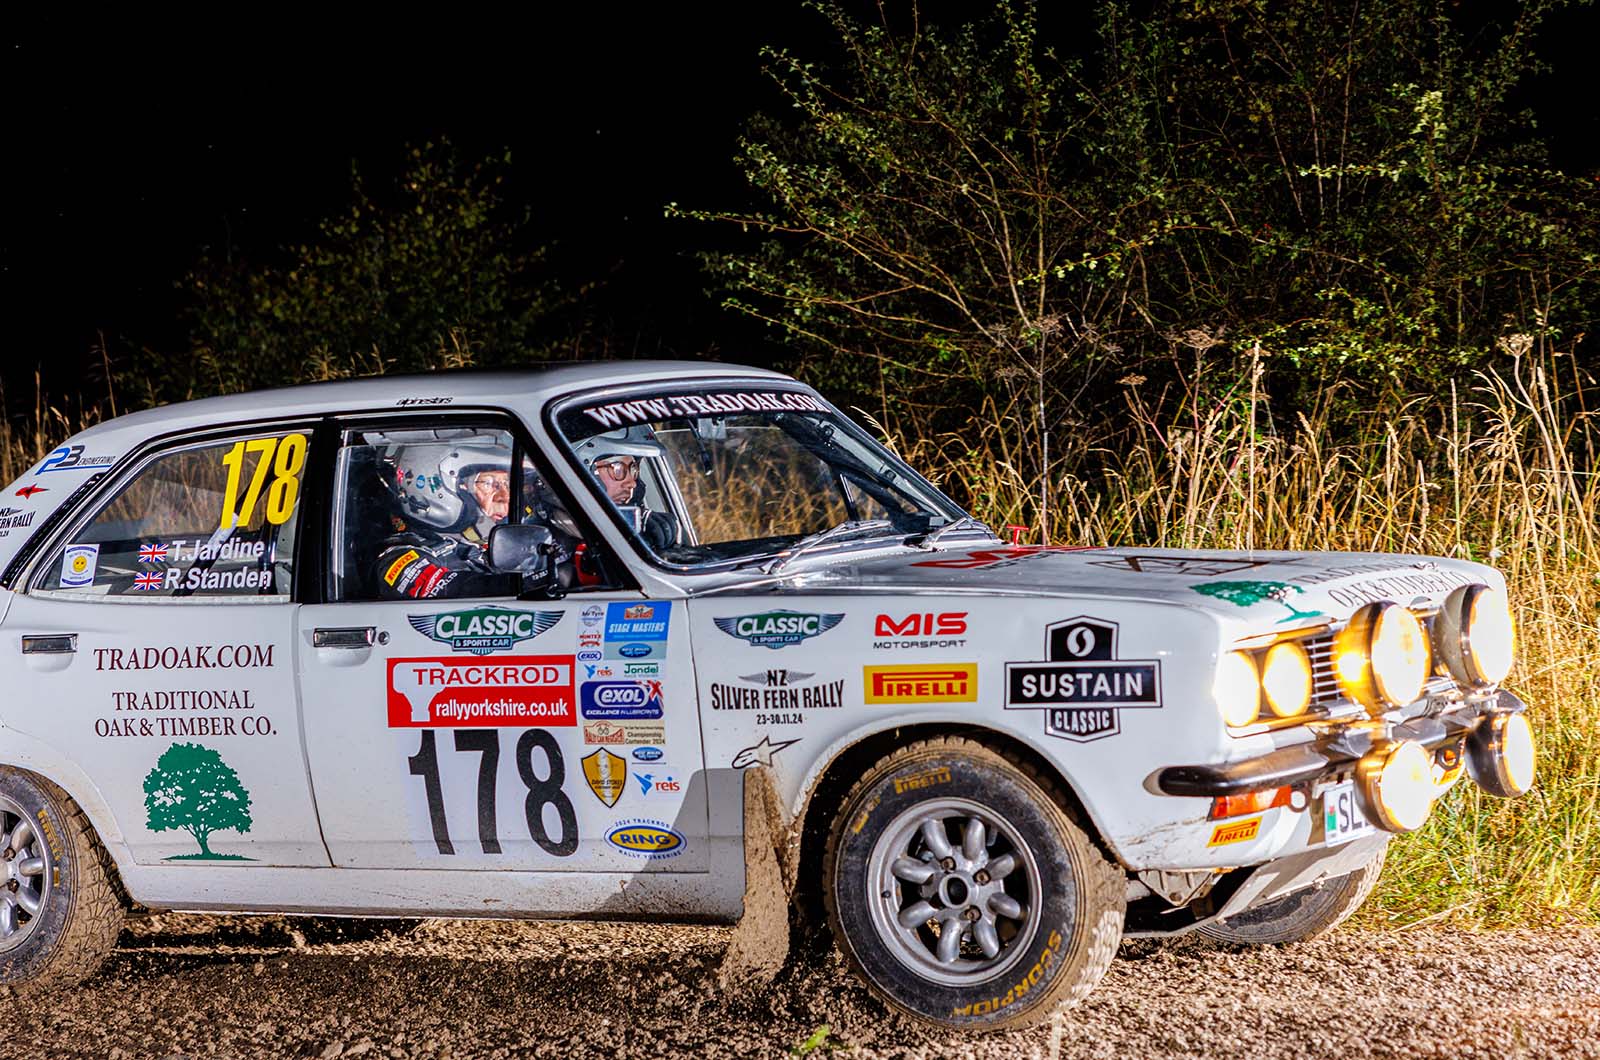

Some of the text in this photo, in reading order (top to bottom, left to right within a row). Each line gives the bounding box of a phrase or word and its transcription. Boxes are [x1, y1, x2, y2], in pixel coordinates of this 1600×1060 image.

[35, 446, 85, 475] P3
[220, 433, 307, 529] 178
[12, 511, 36, 528] RALLY
[172, 538, 265, 562] T.Jardine
[164, 565, 271, 590] R.Standen
[435, 615, 532, 639] CLASSIC
[608, 622, 666, 633] STAGE MASTERS
[737, 617, 818, 636] CLASSIC
[875, 612, 968, 636] MIS
[463, 638, 490, 647] SPORTS
[492, 637, 509, 646] CAR
[873, 640, 967, 649] MOTORSPORT
[93, 645, 274, 671] TRADOAK.COM
[624, 663, 659, 674] Jondel
[413, 667, 559, 686] TRACKROD
[767, 670, 787, 686] NZ
[873, 671, 968, 696] PIRELLI
[1022, 673, 1142, 697] SUSTAIN
[112, 690, 255, 711] TRADITIONAL
[711, 680, 844, 710] SILVER FERN RALLY
[436, 698, 568, 720] rallyyorkshire.co.uk
[757, 713, 803, 725] 23-30.11.24
[156, 716, 235, 737] TIMBER
[241, 716, 277, 736] CO.
[1055, 710, 1110, 733] CLASSIC
[408, 728, 579, 857] 178
[656, 777, 680, 791] reis
[1338, 788, 1370, 833] SL
[620, 834, 671, 845] RING
[1212, 821, 1258, 843] PIRELLI
[952, 929, 1062, 1018] SCORPION
